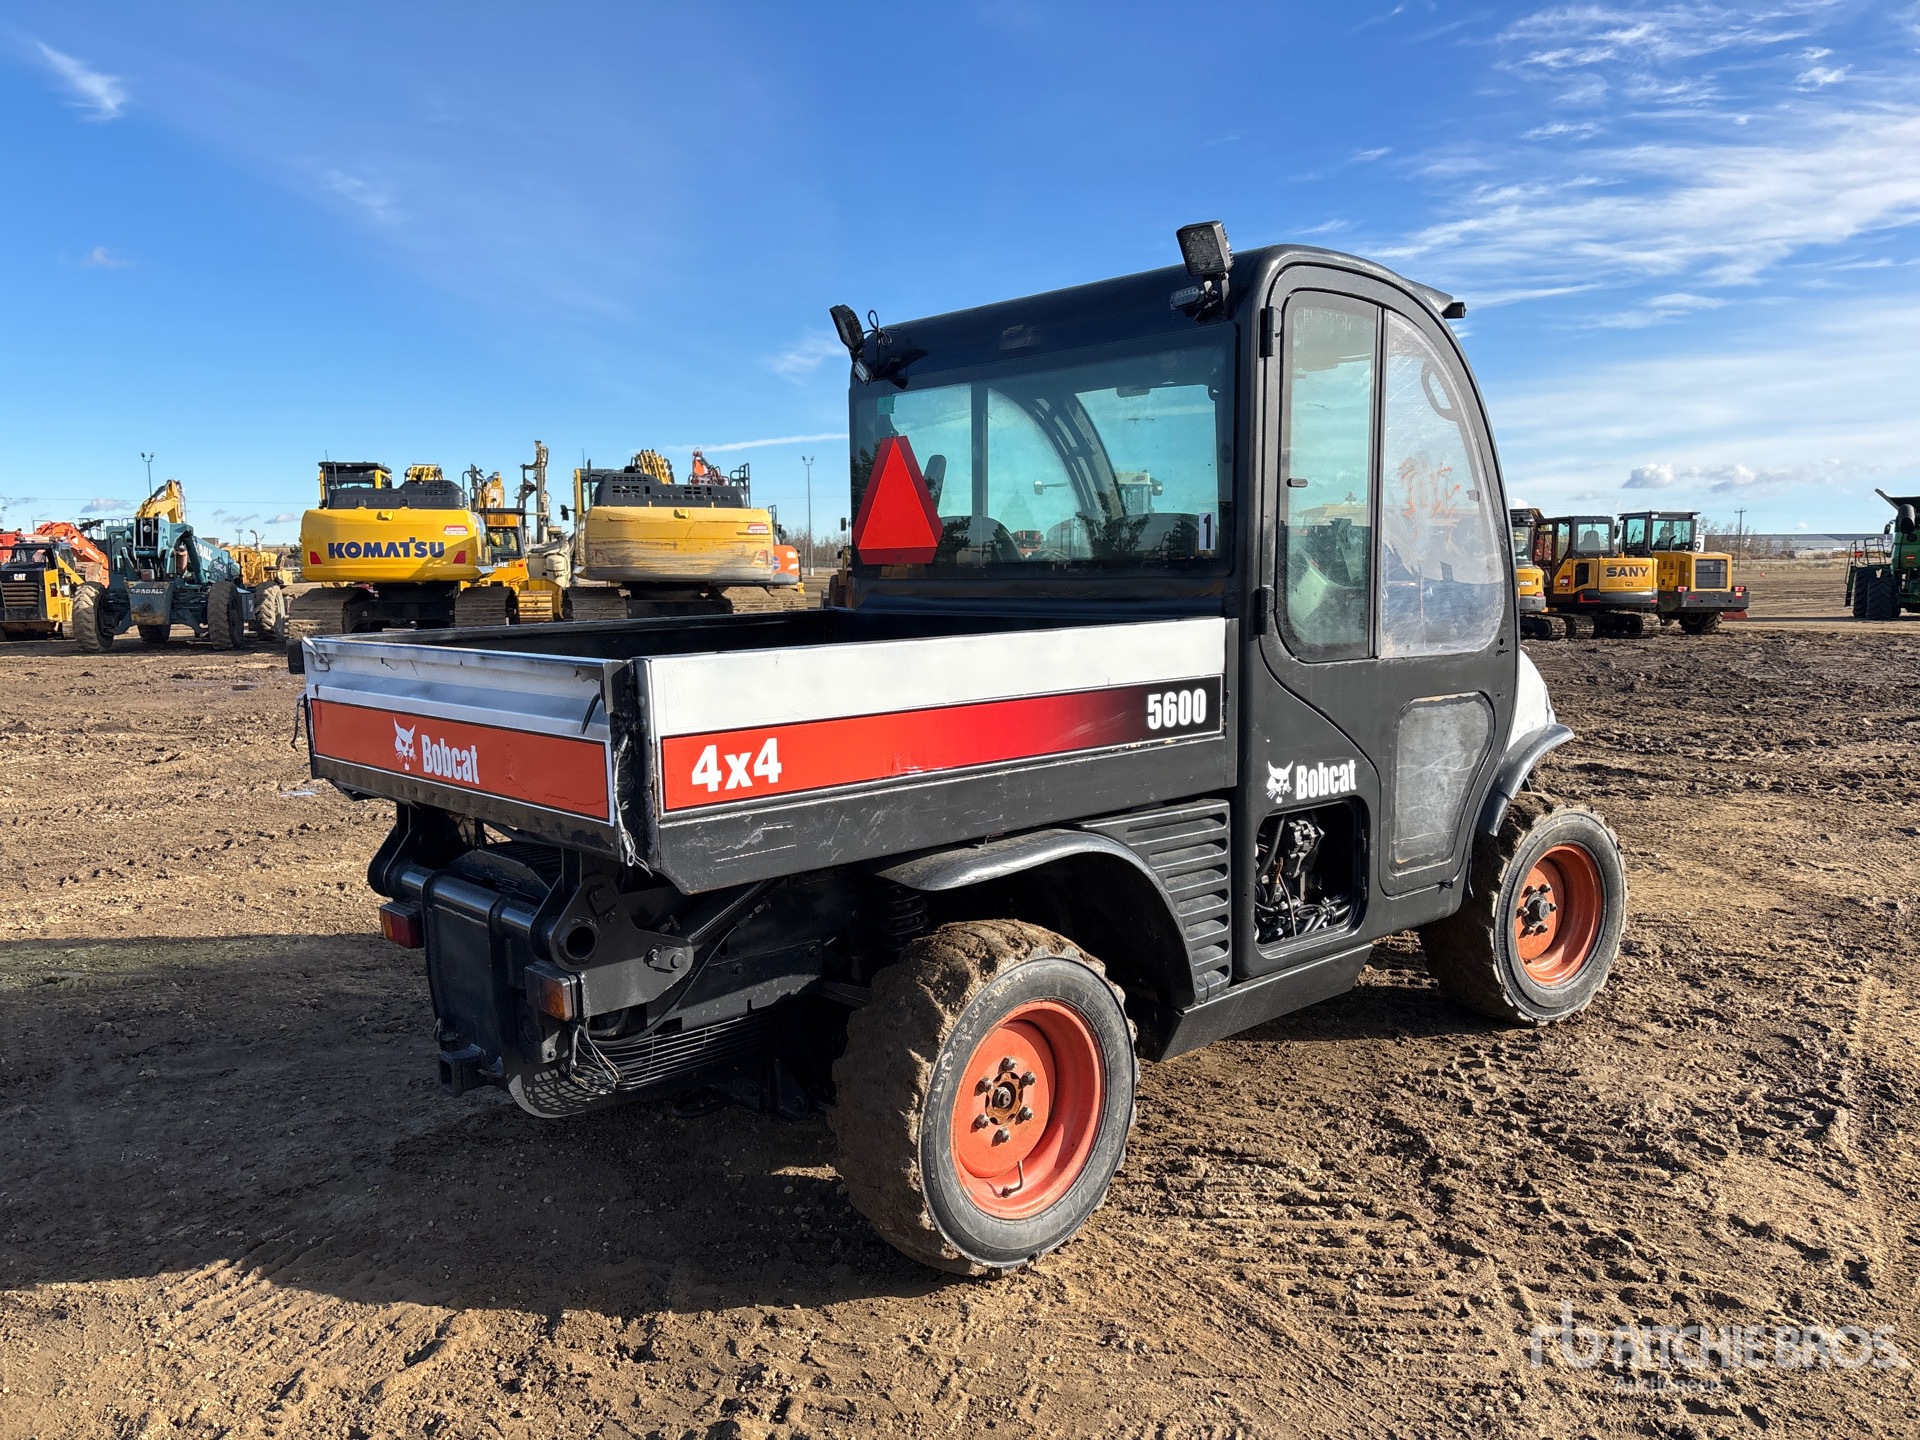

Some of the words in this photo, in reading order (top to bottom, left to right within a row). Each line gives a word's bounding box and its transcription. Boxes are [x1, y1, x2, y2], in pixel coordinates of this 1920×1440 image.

[327, 537, 445, 559] KOMATSU
[1203, 513, 1212, 550] 1
[13, 573, 27, 581] CAT
[1606, 566, 1649, 578] SANY
[1147, 688, 1207, 730] 5600
[421, 734, 480, 785] Bobcat
[691, 737, 783, 793] 4x4
[1296, 759, 1357, 801] Bobcat
